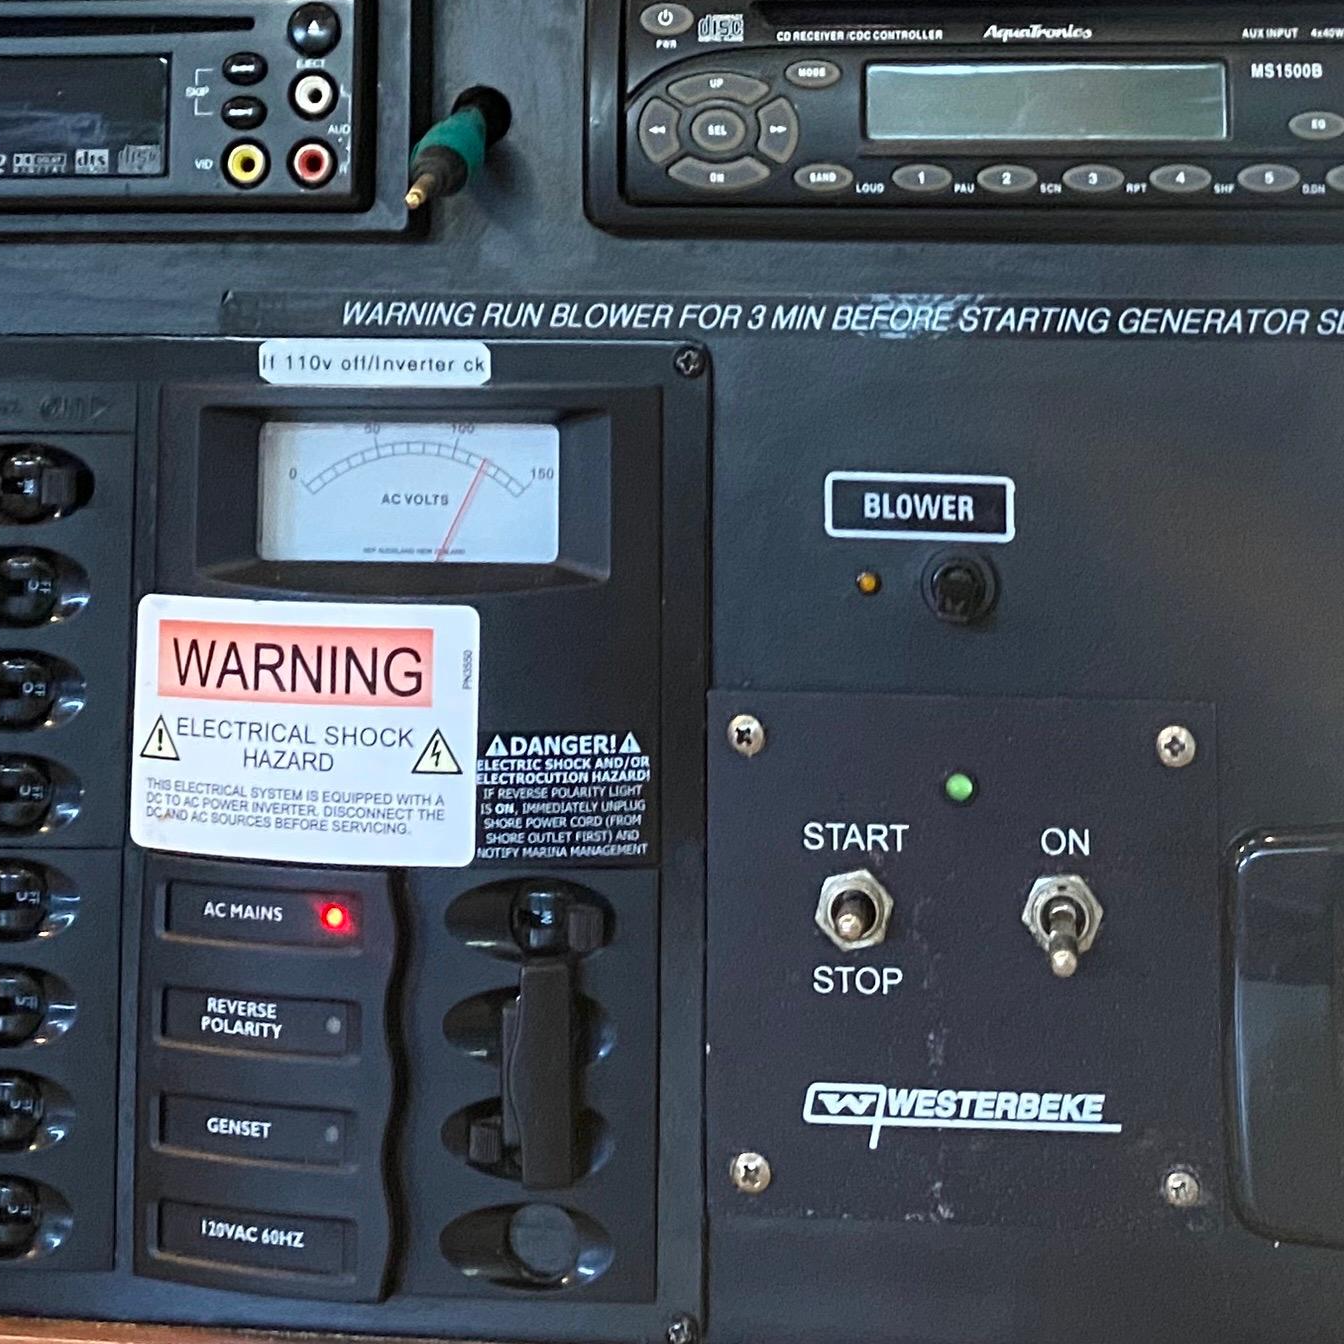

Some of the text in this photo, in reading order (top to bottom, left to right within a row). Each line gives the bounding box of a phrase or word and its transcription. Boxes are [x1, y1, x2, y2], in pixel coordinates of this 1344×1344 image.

[1242, 28, 1263, 39] AUX
[1265, 28, 1298, 39] INPUT
[296, 59, 326, 69] EJECT
[1251, 63, 1323, 78] MS1500B
[186, 87, 209, 97] SKIP
[709, 78, 724, 88] UP
[708, 125, 727, 136] SEL
[195, 159, 213, 170] VID
[809, 172, 837, 183] BAND
[343, 301, 476, 328] WARNING
[483, 302, 542, 328] RUN
[549, 303, 673, 329] BLOWER
[679, 304, 740, 330] FOR
[747, 304, 764, 330] 3
[771, 304, 826, 331] MIN
[833, 305, 950, 332] BEFORE
[958, 307, 1109, 334] STARTING
[1118, 308, 1309, 335] GENERATOR
[262, 355, 485, 372] If 110v off/Inverter ck
[530, 468, 554, 480] 150
[381, 493, 449, 506] AC VOLTS
[864, 493, 974, 521] BLOWER
[173, 637, 423, 698] WARNING
[177, 717, 414, 748] ELECTRICAL SHOCK
[510, 734, 616, 756] DANGER!
[243, 749, 334, 773] HAZARD
[477, 755, 650, 771] ELECTRIC SHOCK AND/OR
[476, 771, 588, 785] ELECTROCUTION
[147, 777, 444, 806] THIS ELECTRICAL SYSTEM IS EQUIPPED WITH A
[803, 823, 909, 853] START
[1041, 828, 1090, 855] ON
[204, 901, 283, 923] AC MAINS
[813, 966, 903, 995] STOP
[207, 997, 277, 1020] REVERSE
[201, 1016, 282, 1040] POLARITY
[887, 1088, 1105, 1122] WESTERBEKE
[206, 1117, 271, 1140] GENSET
[201, 1219, 305, 1249] 120VAC 60HZ
